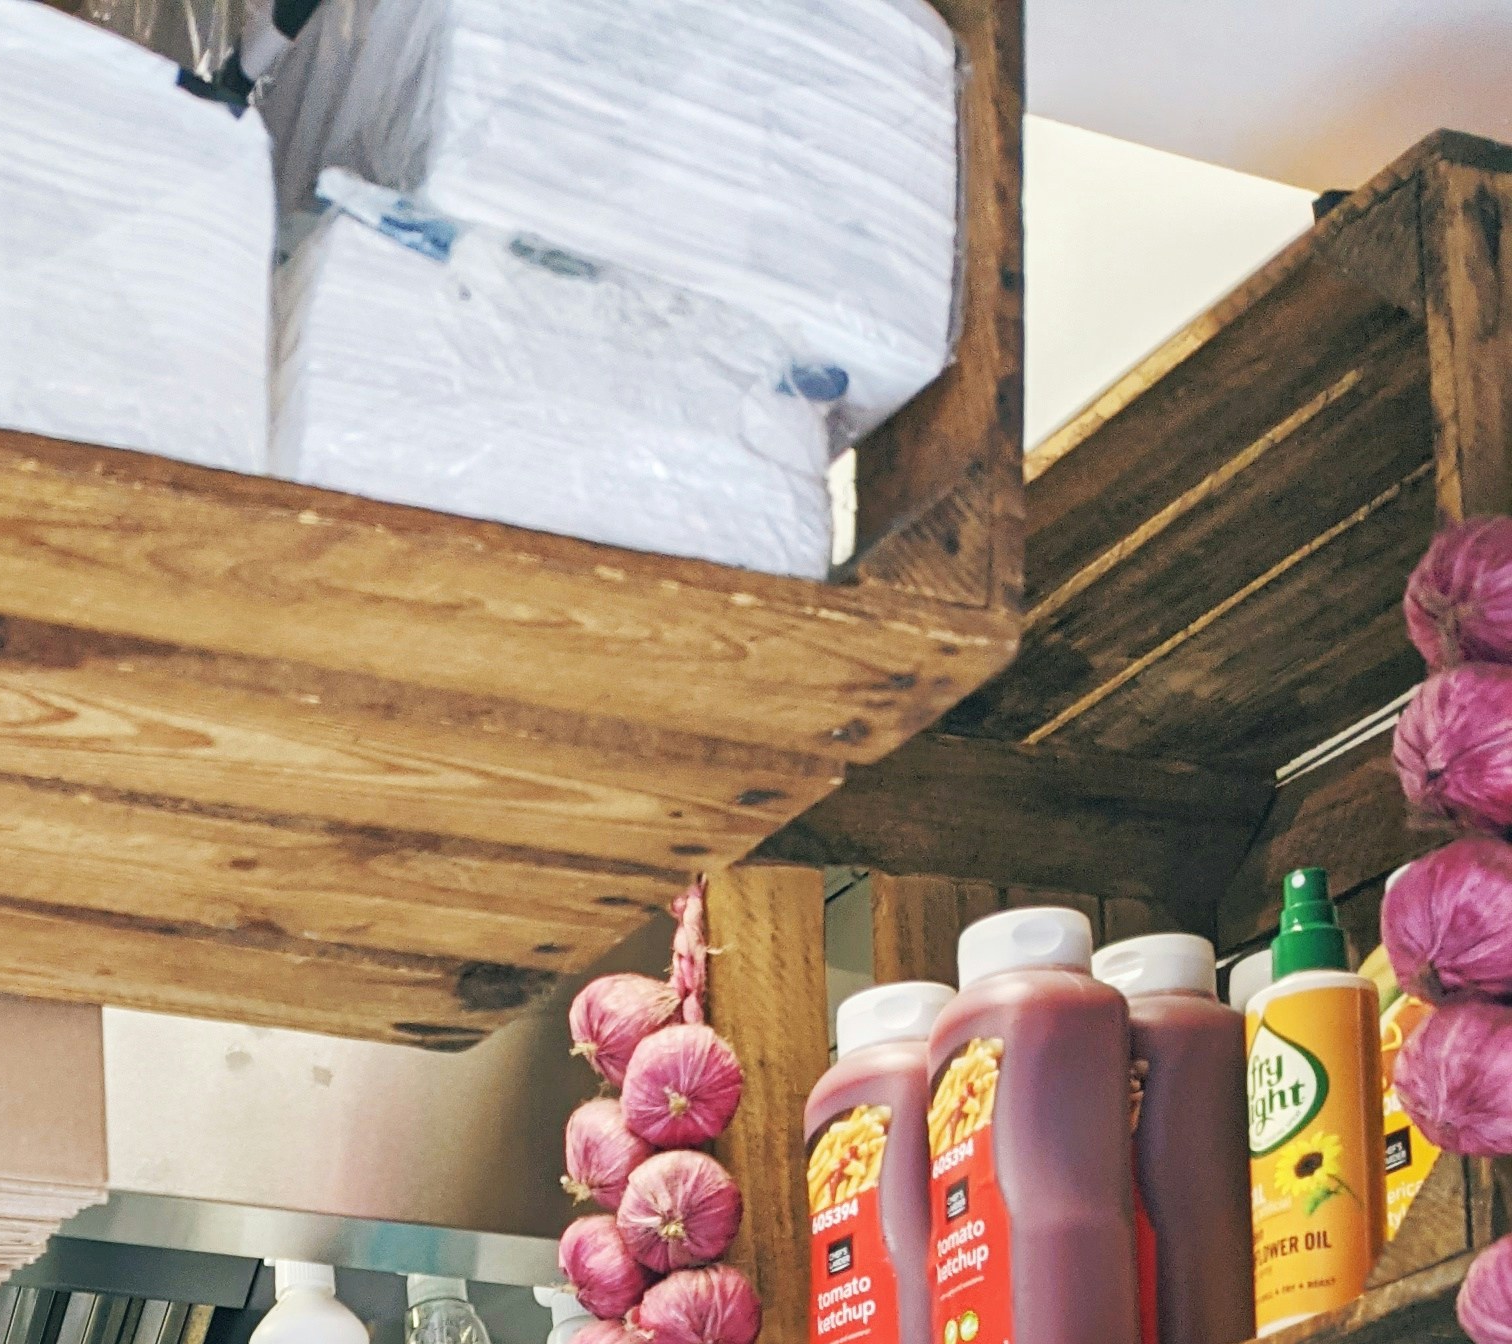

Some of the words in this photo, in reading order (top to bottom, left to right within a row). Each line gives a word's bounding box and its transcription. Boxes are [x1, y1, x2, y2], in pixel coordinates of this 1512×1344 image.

[1251, 1054, 1283, 1096] fry
[1250, 1079, 1306, 1136] ight
[812, 1198, 859, 1235] 605394
[937, 1220, 985, 1257] tomato
[1304, 1231, 1332, 1251] OIL
[817, 1276, 871, 1310] tomato
[817, 1300, 876, 1335] ketchup
